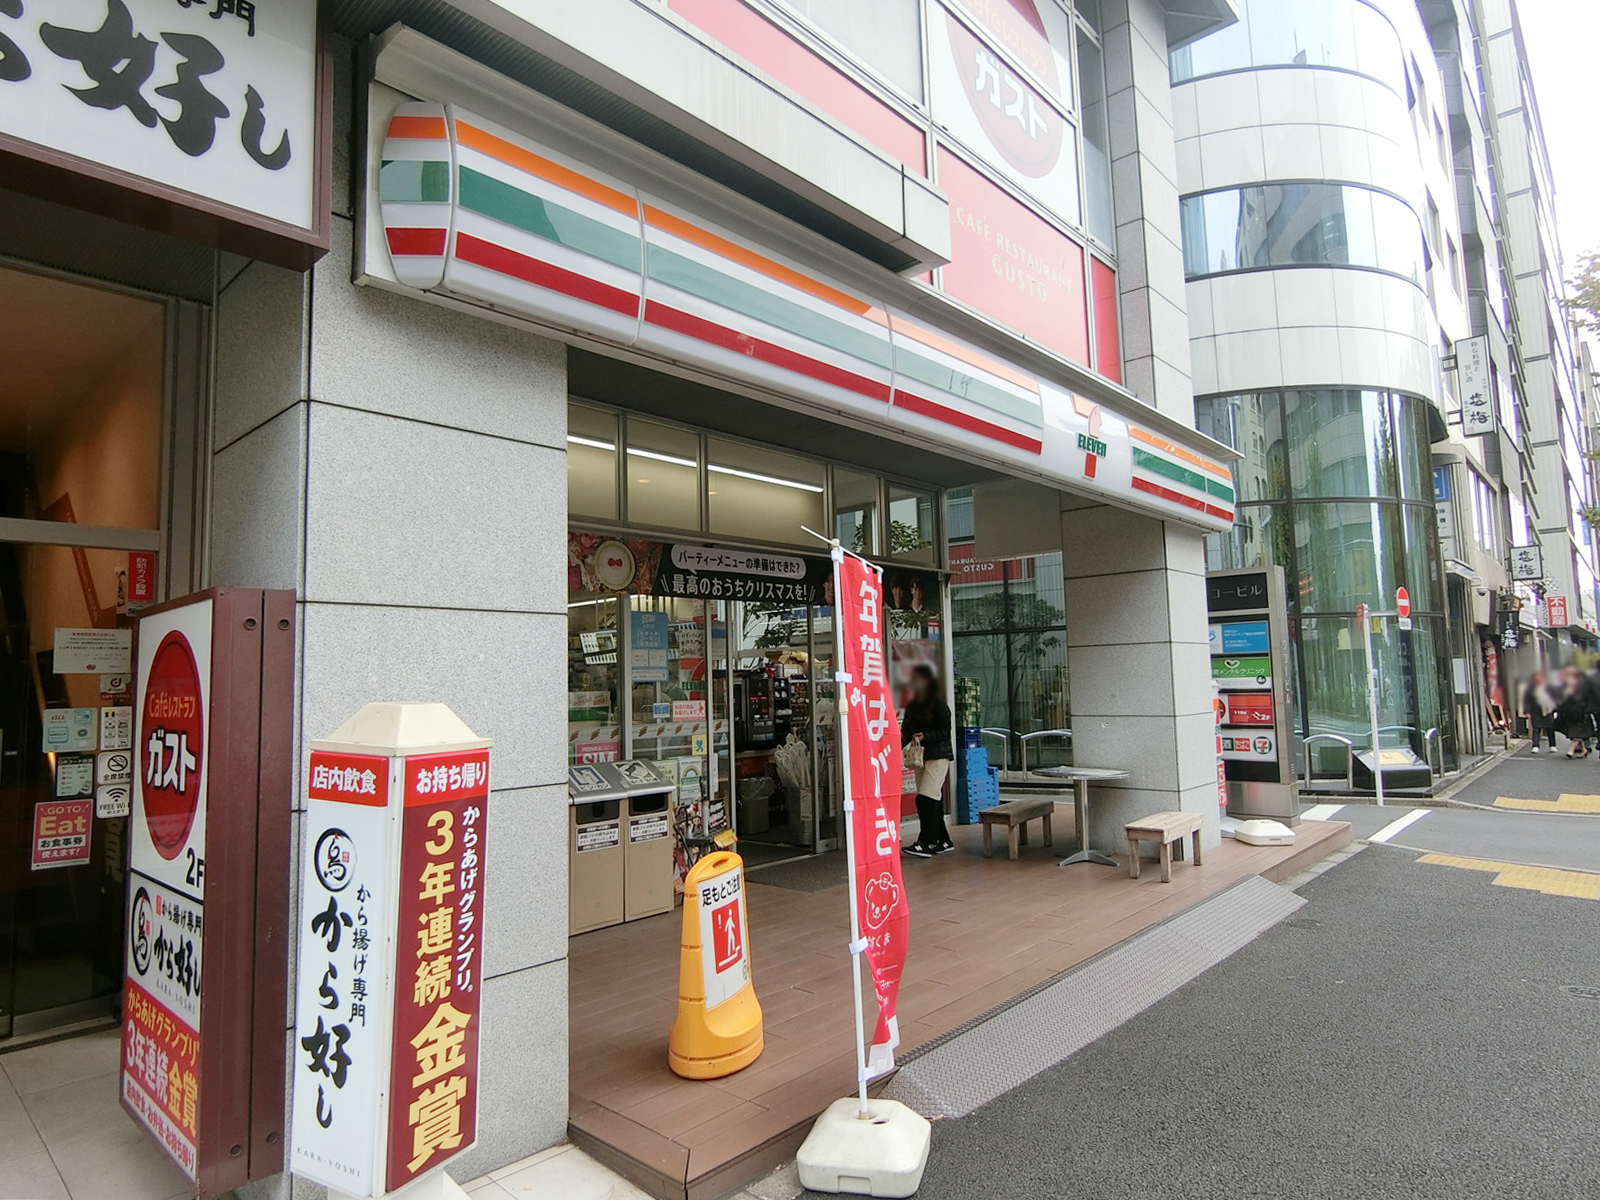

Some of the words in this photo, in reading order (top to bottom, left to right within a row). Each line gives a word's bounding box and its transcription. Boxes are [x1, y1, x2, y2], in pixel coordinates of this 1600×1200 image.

[975, 49, 1049, 141] ガスト
[991, 255, 1048, 303] GUSTO
[996, 232, 1073, 294] RESTAURANT
[1077, 434, 1107, 457] ELEVEN
[1551, 597, 1565, 626] 不動産
[682, 681, 706, 690] ELEVE
[148, 691, 196, 718] Caféレストラン
[146, 729, 197, 793] ガスト
[583, 751, 615, 764] SIM
[312, 765, 377, 795] 店内飲食
[417, 761, 487, 795] お持ち帰り
[39, 815, 87, 836] Eat
[46, 806, 64, 815] GO
[66, 804, 82, 814] TO
[40, 836, 83, 849] お食事券
[186, 846, 204, 889] 2F
[153, 923, 202, 998] から好し
[349, 884, 372, 1027] から揚げ専門
[406, 809, 473, 1174] 3年連続金賞
[301, 895, 353, 1129] から好し
[296, 1146, 362, 1178] KARA-YOSHI
